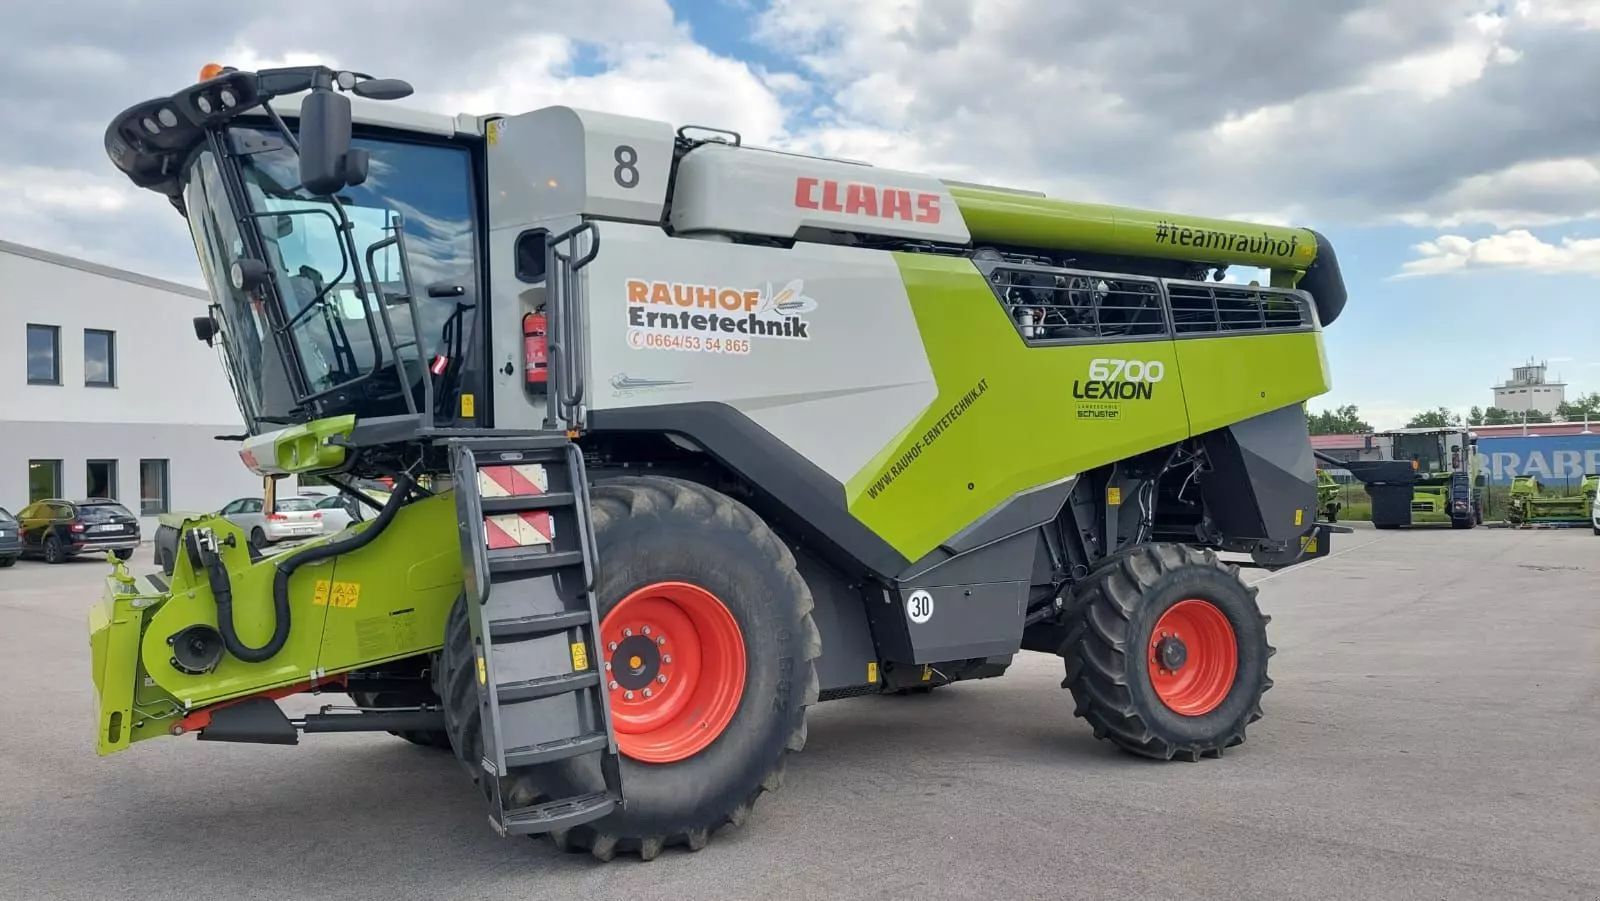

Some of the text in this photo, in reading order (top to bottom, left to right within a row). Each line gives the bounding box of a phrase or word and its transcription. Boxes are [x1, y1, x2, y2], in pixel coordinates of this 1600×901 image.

[614, 145, 640, 189] 8
[795, 177, 941, 224] CLAAS
[1155, 220, 1298, 257] #teamrauhof
[628, 280, 760, 312] RAUHOF
[628, 306, 808, 338] Erntetechnik
[646, 333, 749, 353] 0664/53 54 865
[1089, 358, 1165, 383] 6700
[1072, 380, 1153, 400] LEXION
[867, 378, 989, 500] WWW.RAUHOF-ERNTETECHNIK.AT
[912, 596, 929, 617] 30
